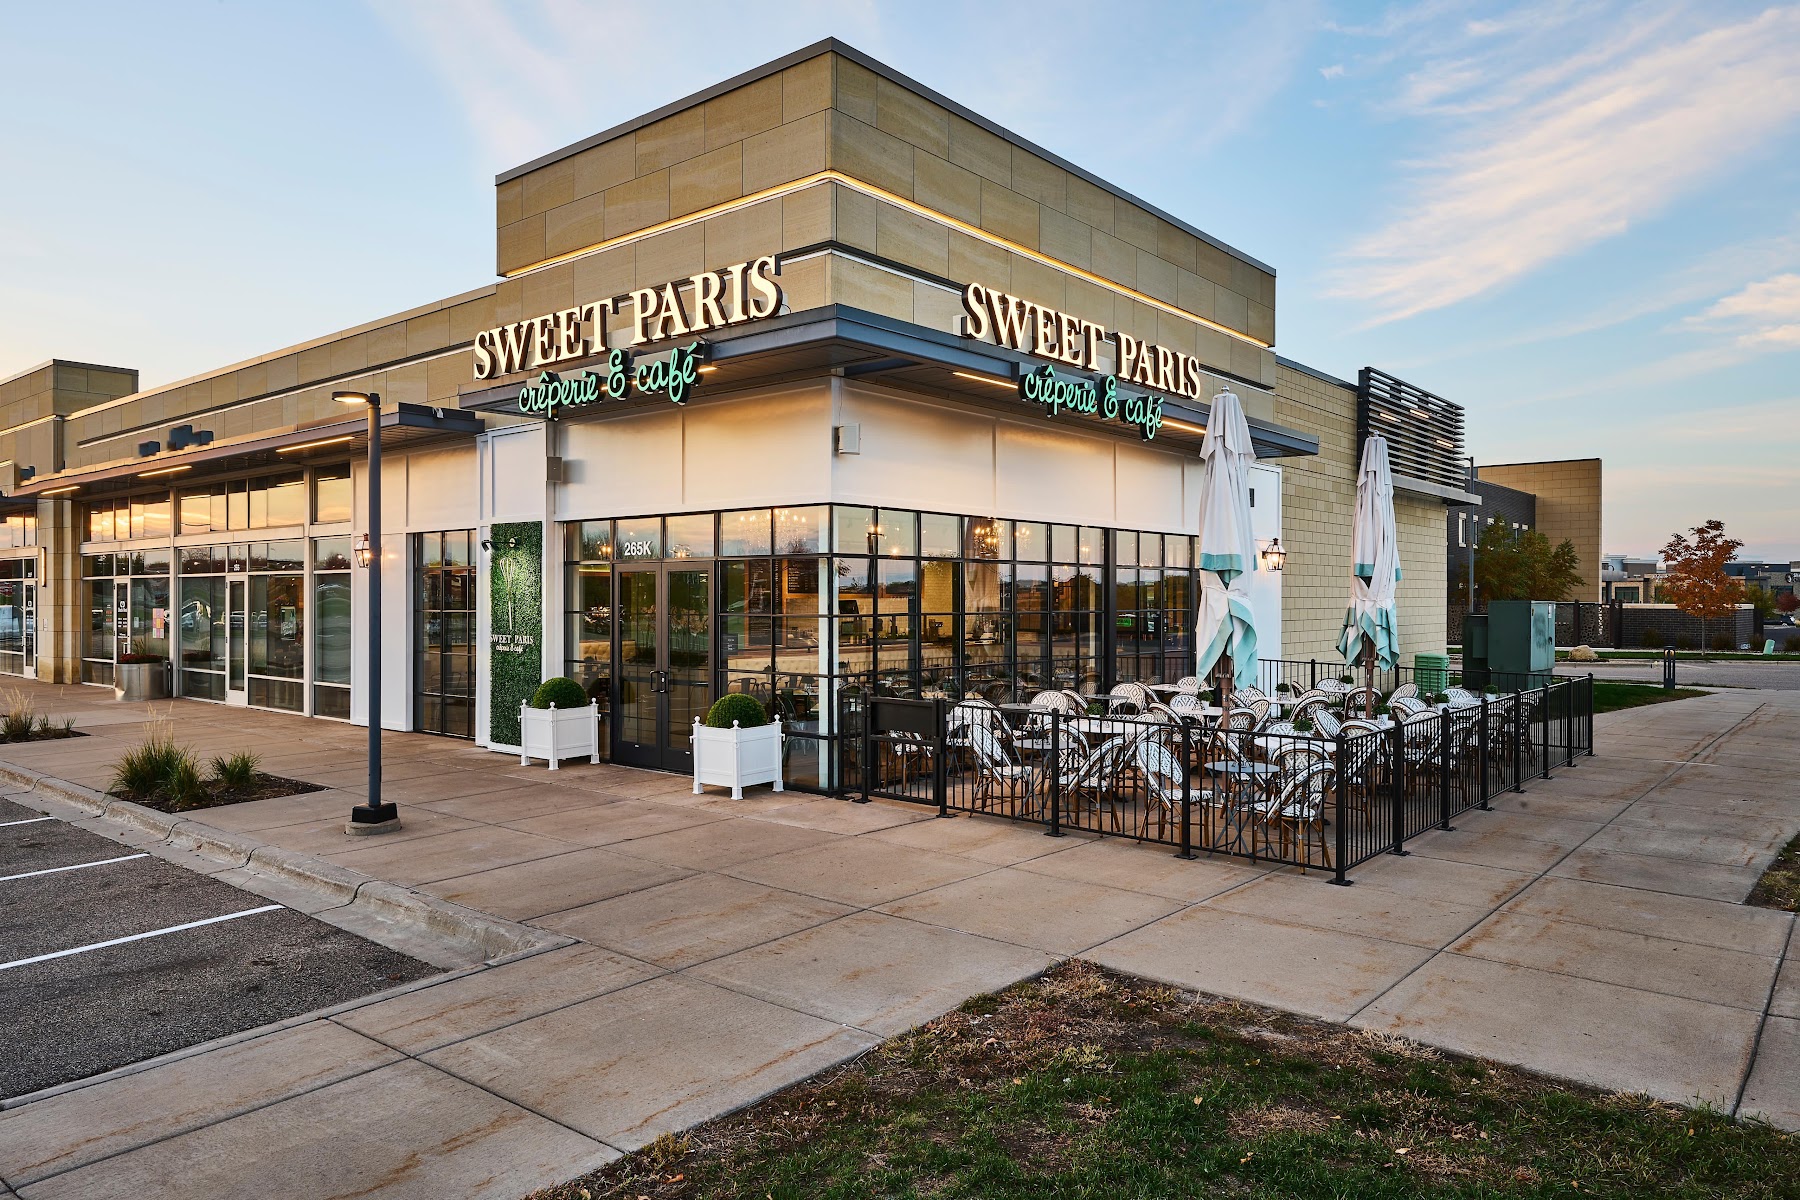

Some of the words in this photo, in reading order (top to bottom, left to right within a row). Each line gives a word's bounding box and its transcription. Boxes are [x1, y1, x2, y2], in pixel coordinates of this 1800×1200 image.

[473, 297, 617, 380] SWEET
[628, 255, 783, 345] PARIS
[963, 282, 1105, 372] SWEET
[1114, 331, 1201, 400] PARIS
[518, 370, 600, 419] crêperie
[606, 348, 627, 399] &
[635, 341, 699, 404] café
[1024, 364, 1098, 415] crêperie
[1103, 375, 1119, 420] &
[1125, 396, 1164, 440] café
[624, 540, 652, 556] 265K
[514, 635, 533, 644] PARIS
